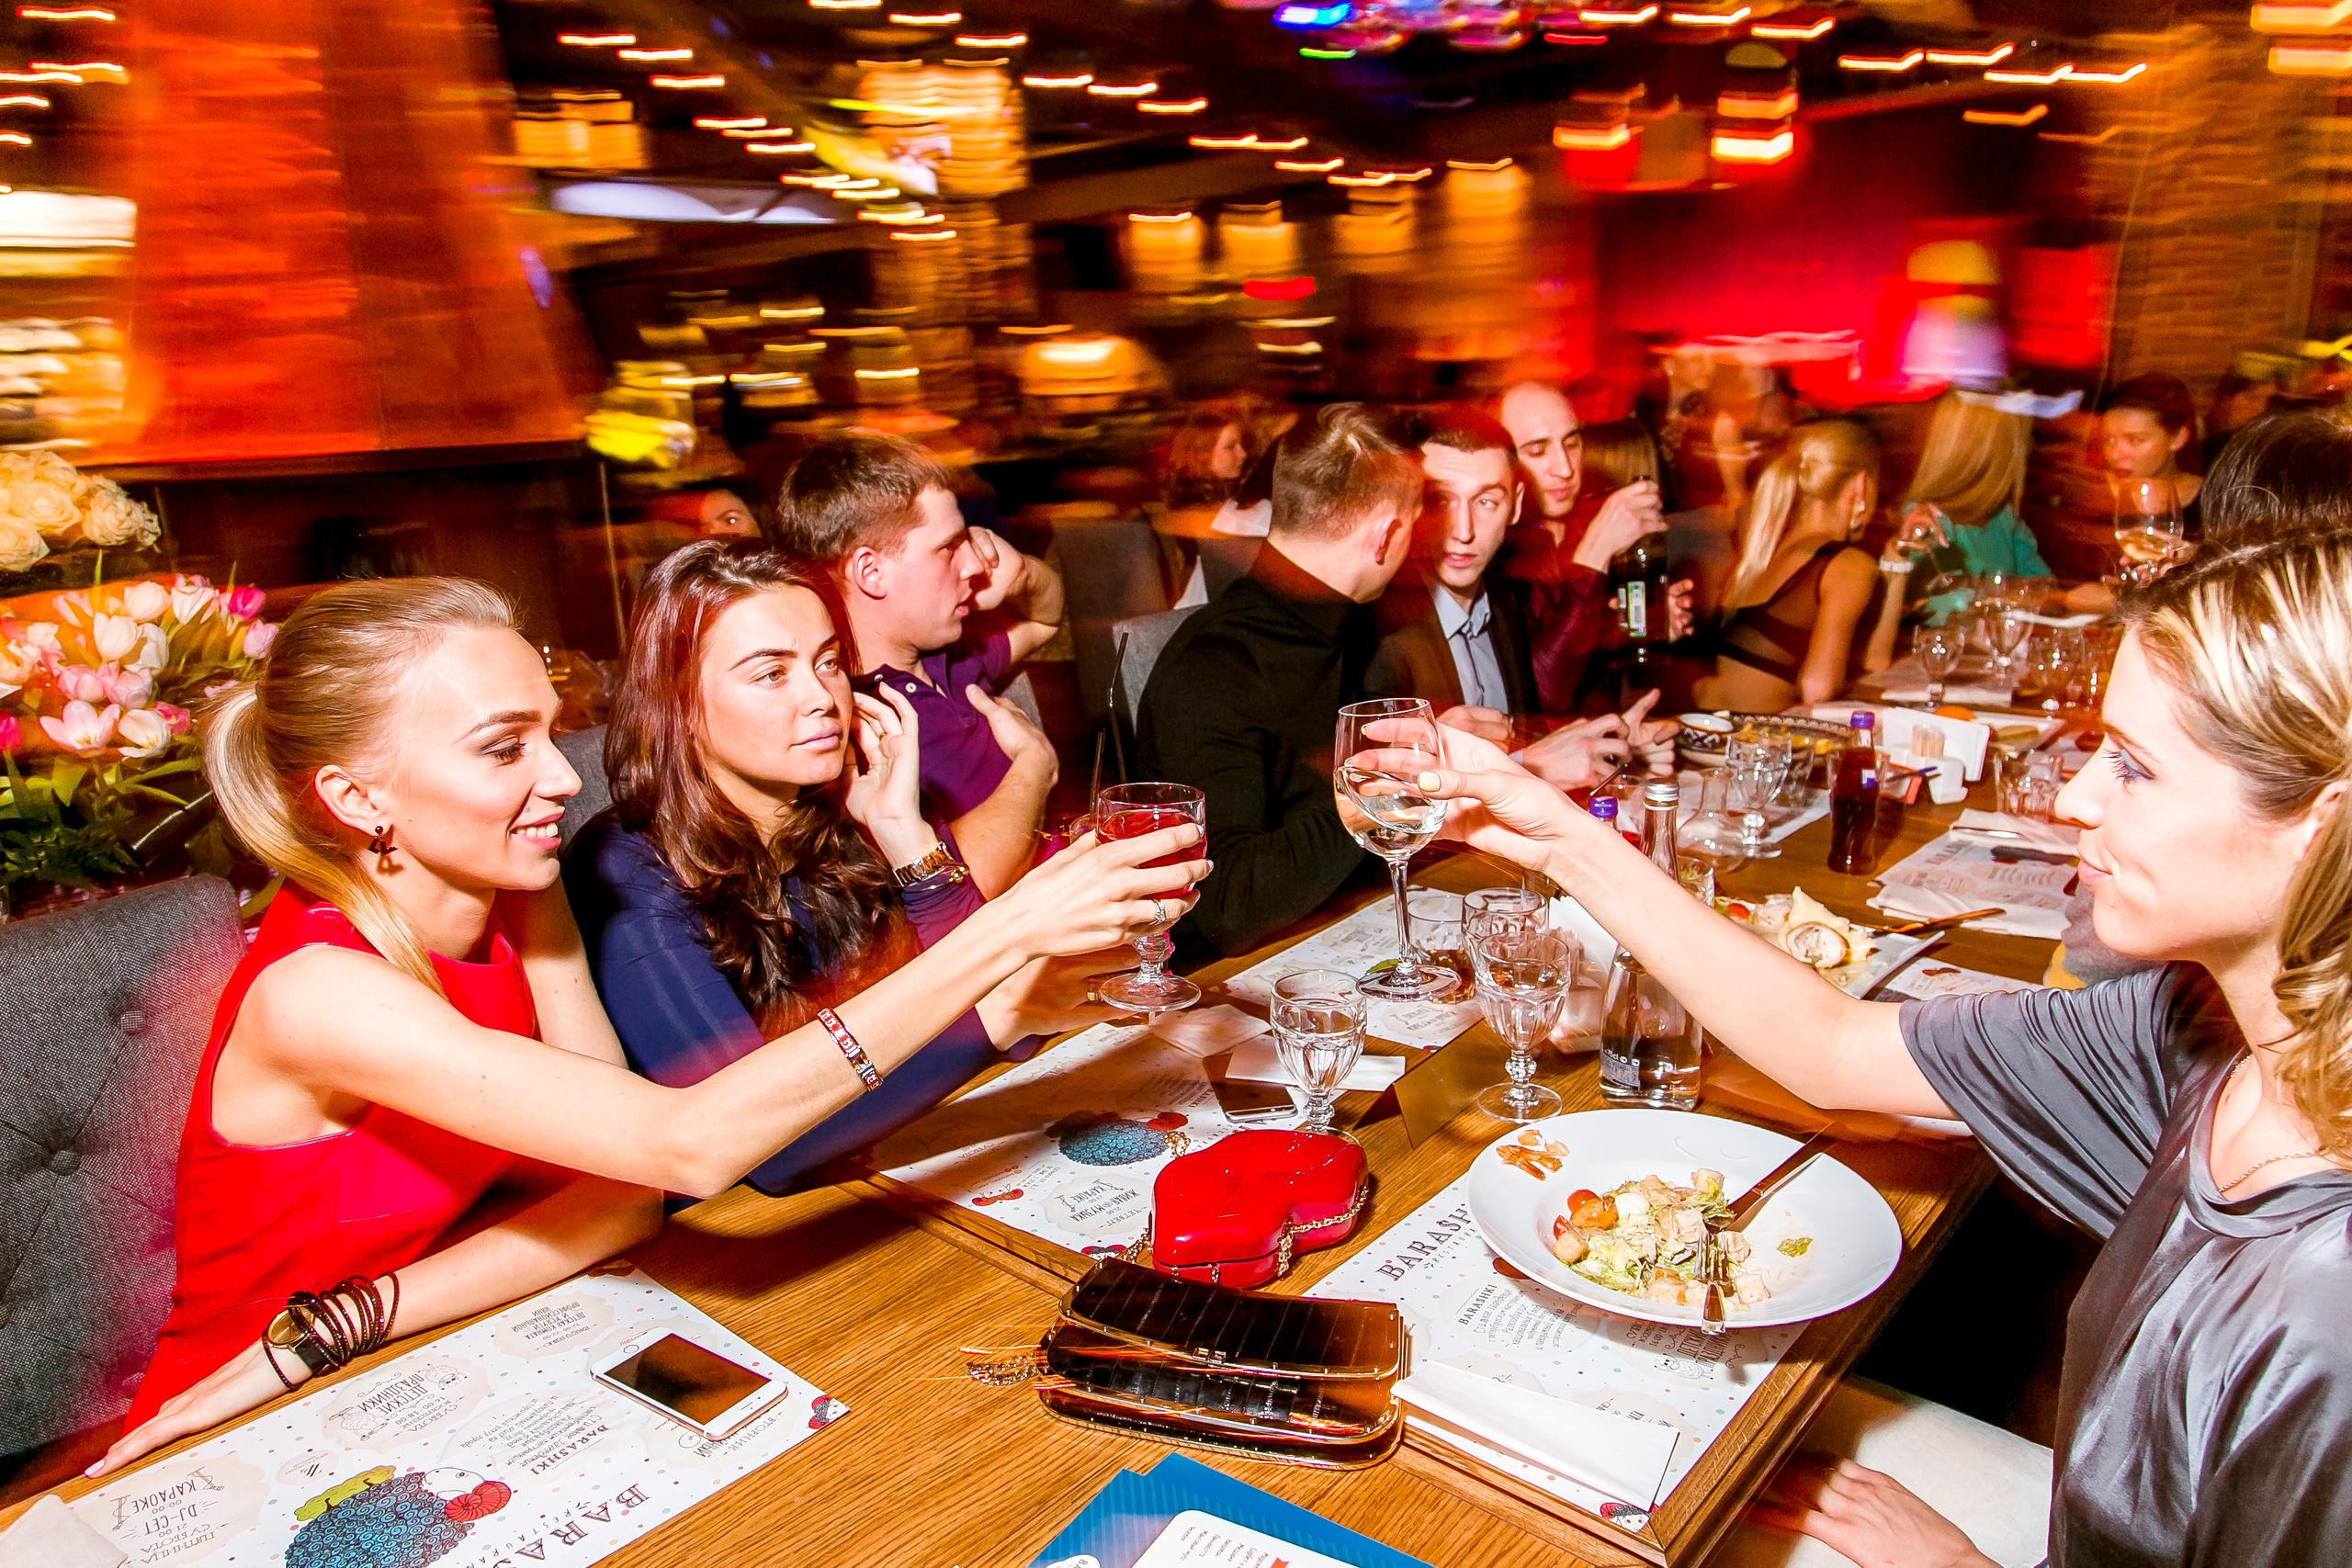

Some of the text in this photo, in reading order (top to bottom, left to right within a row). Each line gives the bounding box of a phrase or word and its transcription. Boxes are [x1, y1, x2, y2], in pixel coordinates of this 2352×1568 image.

[1069, 1185, 1107, 1203] КАРАОКЕ
[1069, 1189, 1139, 1222] ЖИВАЯ МУЗЫКА
[1104, 1208, 1142, 1226] ЧЕТВЕРГ
[1374, 1207, 1472, 1280] BARASH
[1430, 1227, 1478, 1262] RESTAURA
[509, 1301, 581, 1333] ПРОФЕССИОНАЛЬНОЙ
[530, 1305, 551, 1316] НЯНИ
[1457, 1283, 1497, 1325] BARASHKI
[524, 1312, 587, 1339] ДЕТСКАЯ КОМНАТА
[531, 1315, 561, 1329] УСЛУГИ
[356, 1372, 424, 1412] ПРАЗДНИКИ
[374, 1383, 427, 1415] ДЕТСКИЕ
[399, 1399, 452, 1429] ВОСКРЕСЕНЬЕ
[406, 1404, 458, 1434] СУББОТА
[528, 1424, 608, 1475] BARASHKI
[726, 1416, 775, 1451] ВТОРНИК
[130, 1479, 196, 1514] КАРАОКЕ
[150, 1498, 182, 1515] 00:00
[141, 1503, 198, 1535] DJ-СЕТ
[157, 1522, 187, 1538] 21:00
[139, 1521, 211, 1553] СУББОТА
[139, 1530, 215, 1564] ПЯТНИЦА
